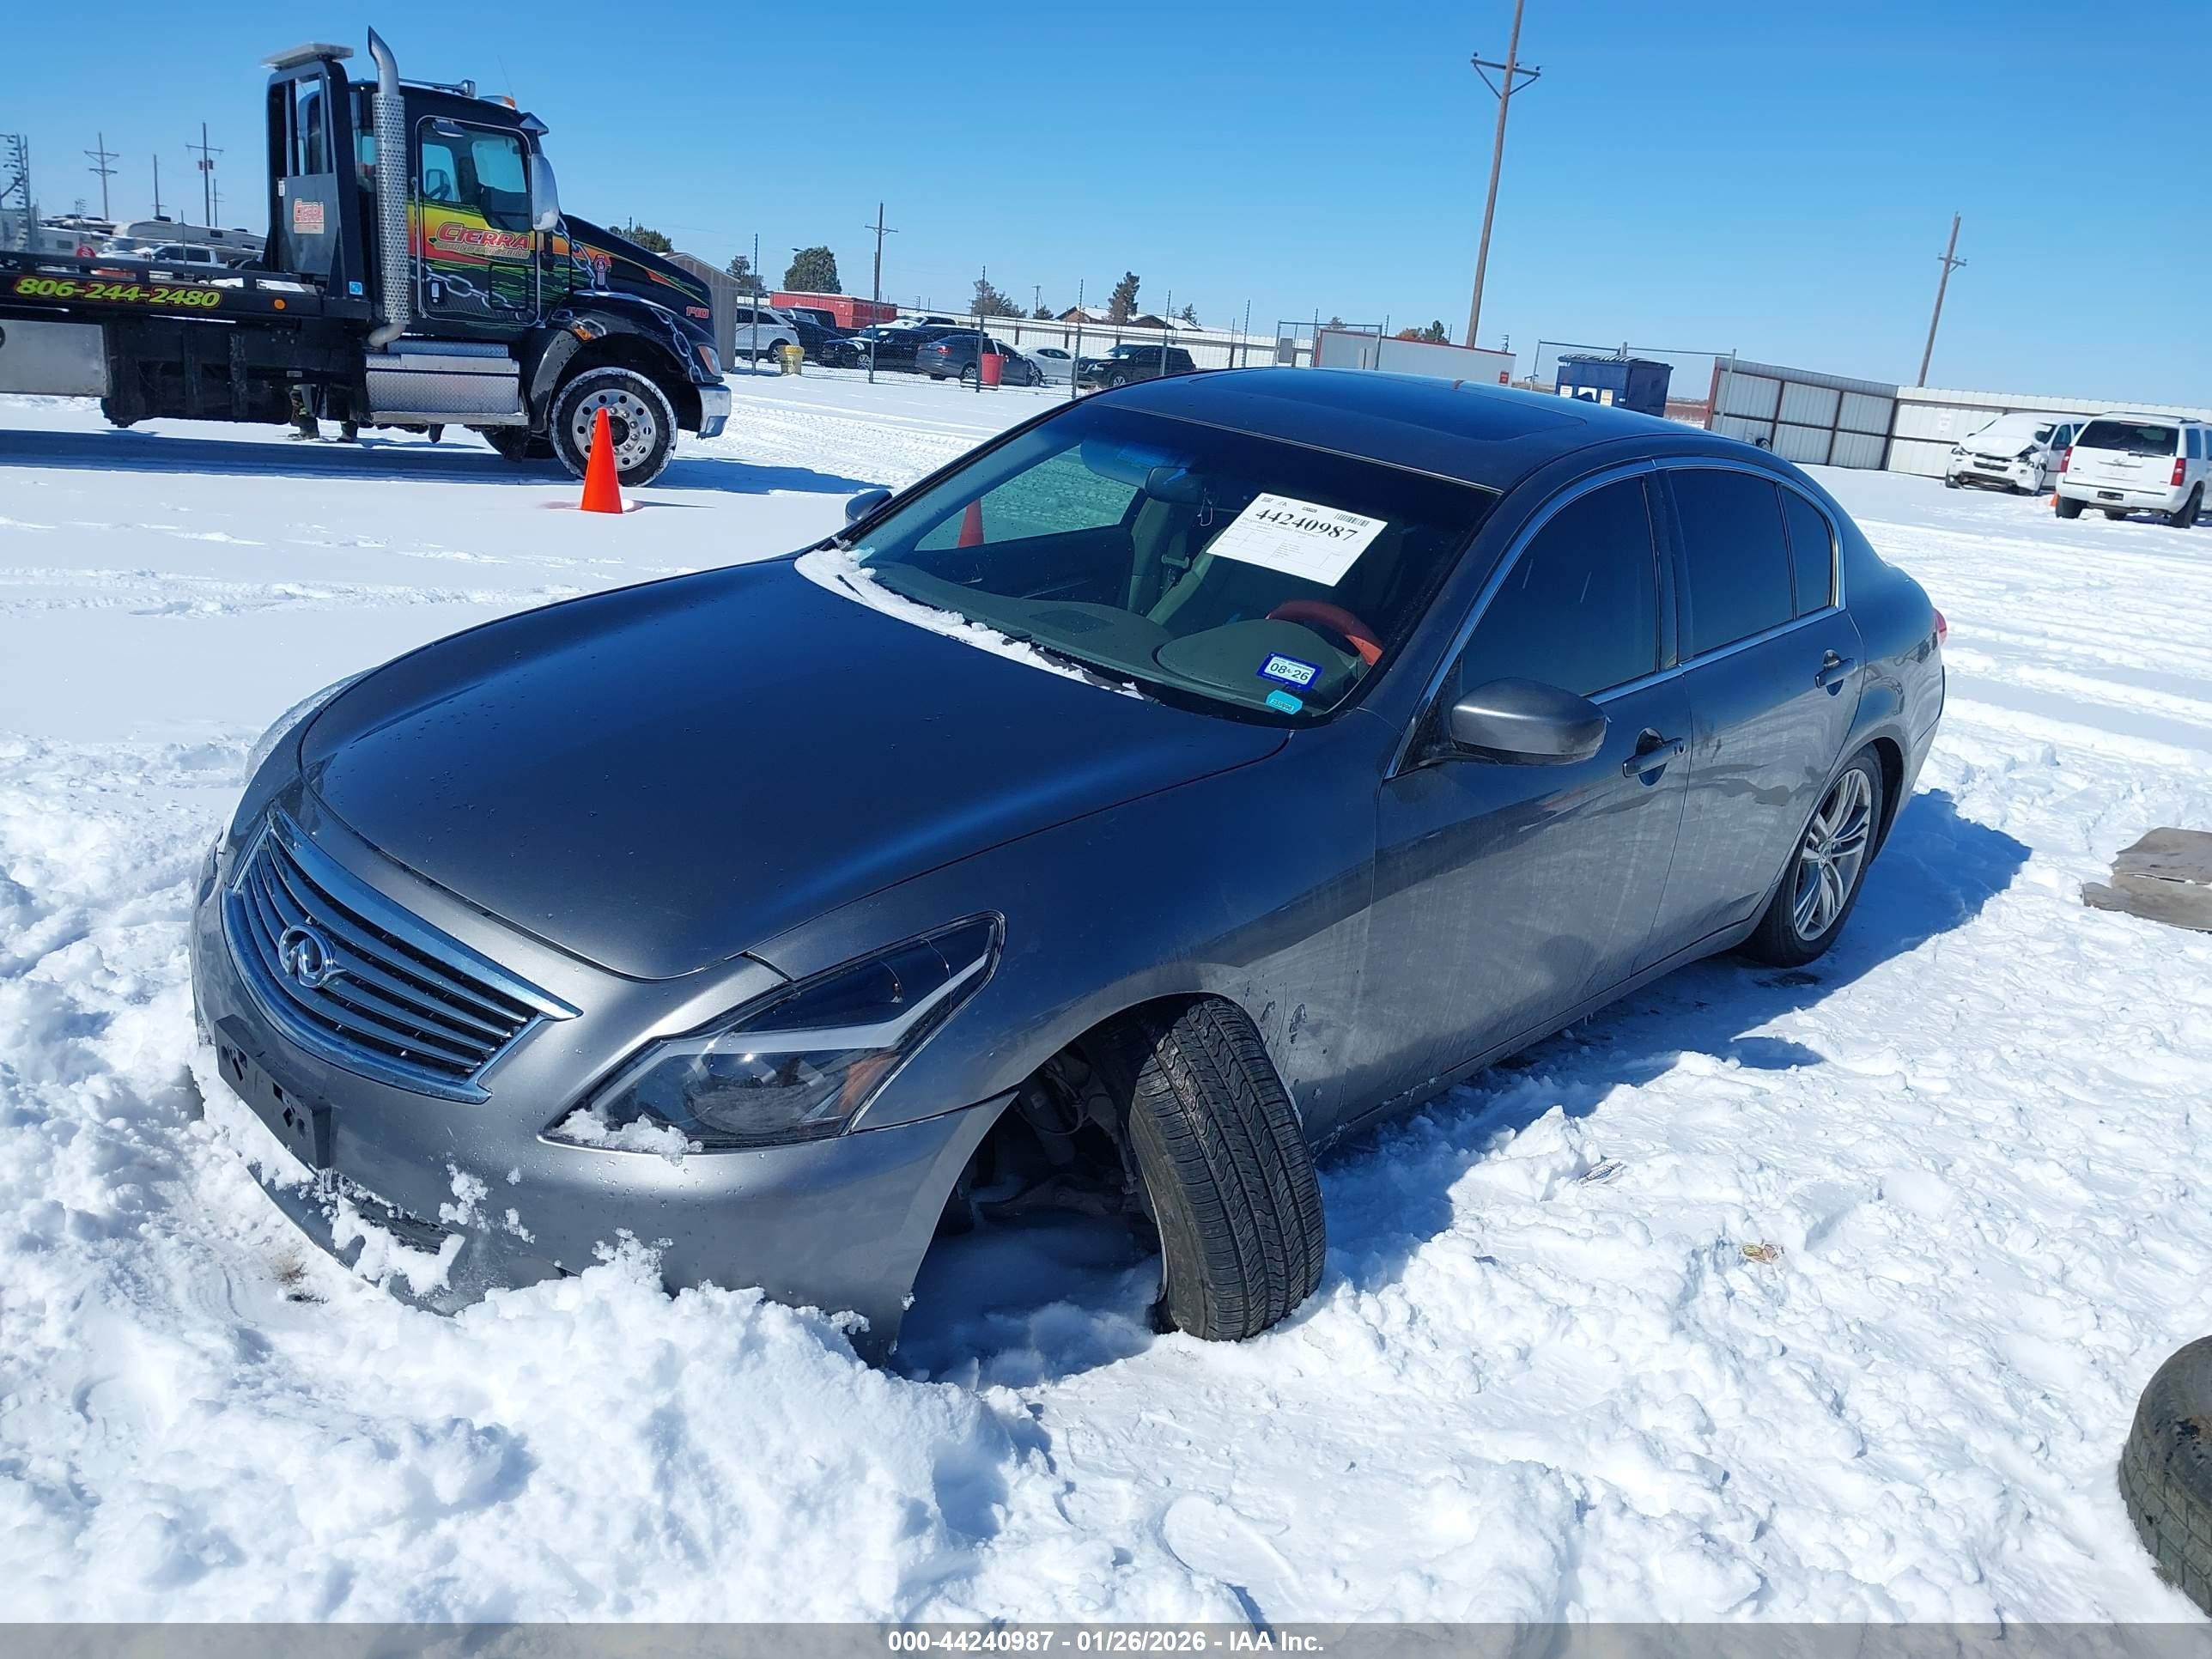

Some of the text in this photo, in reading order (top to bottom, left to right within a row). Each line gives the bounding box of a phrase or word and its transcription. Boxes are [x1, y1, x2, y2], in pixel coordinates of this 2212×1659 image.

[436, 222, 530, 251] CIERRA
[15, 276, 222, 307] 806-244-2480
[1255, 508, 1358, 541] 44240987
